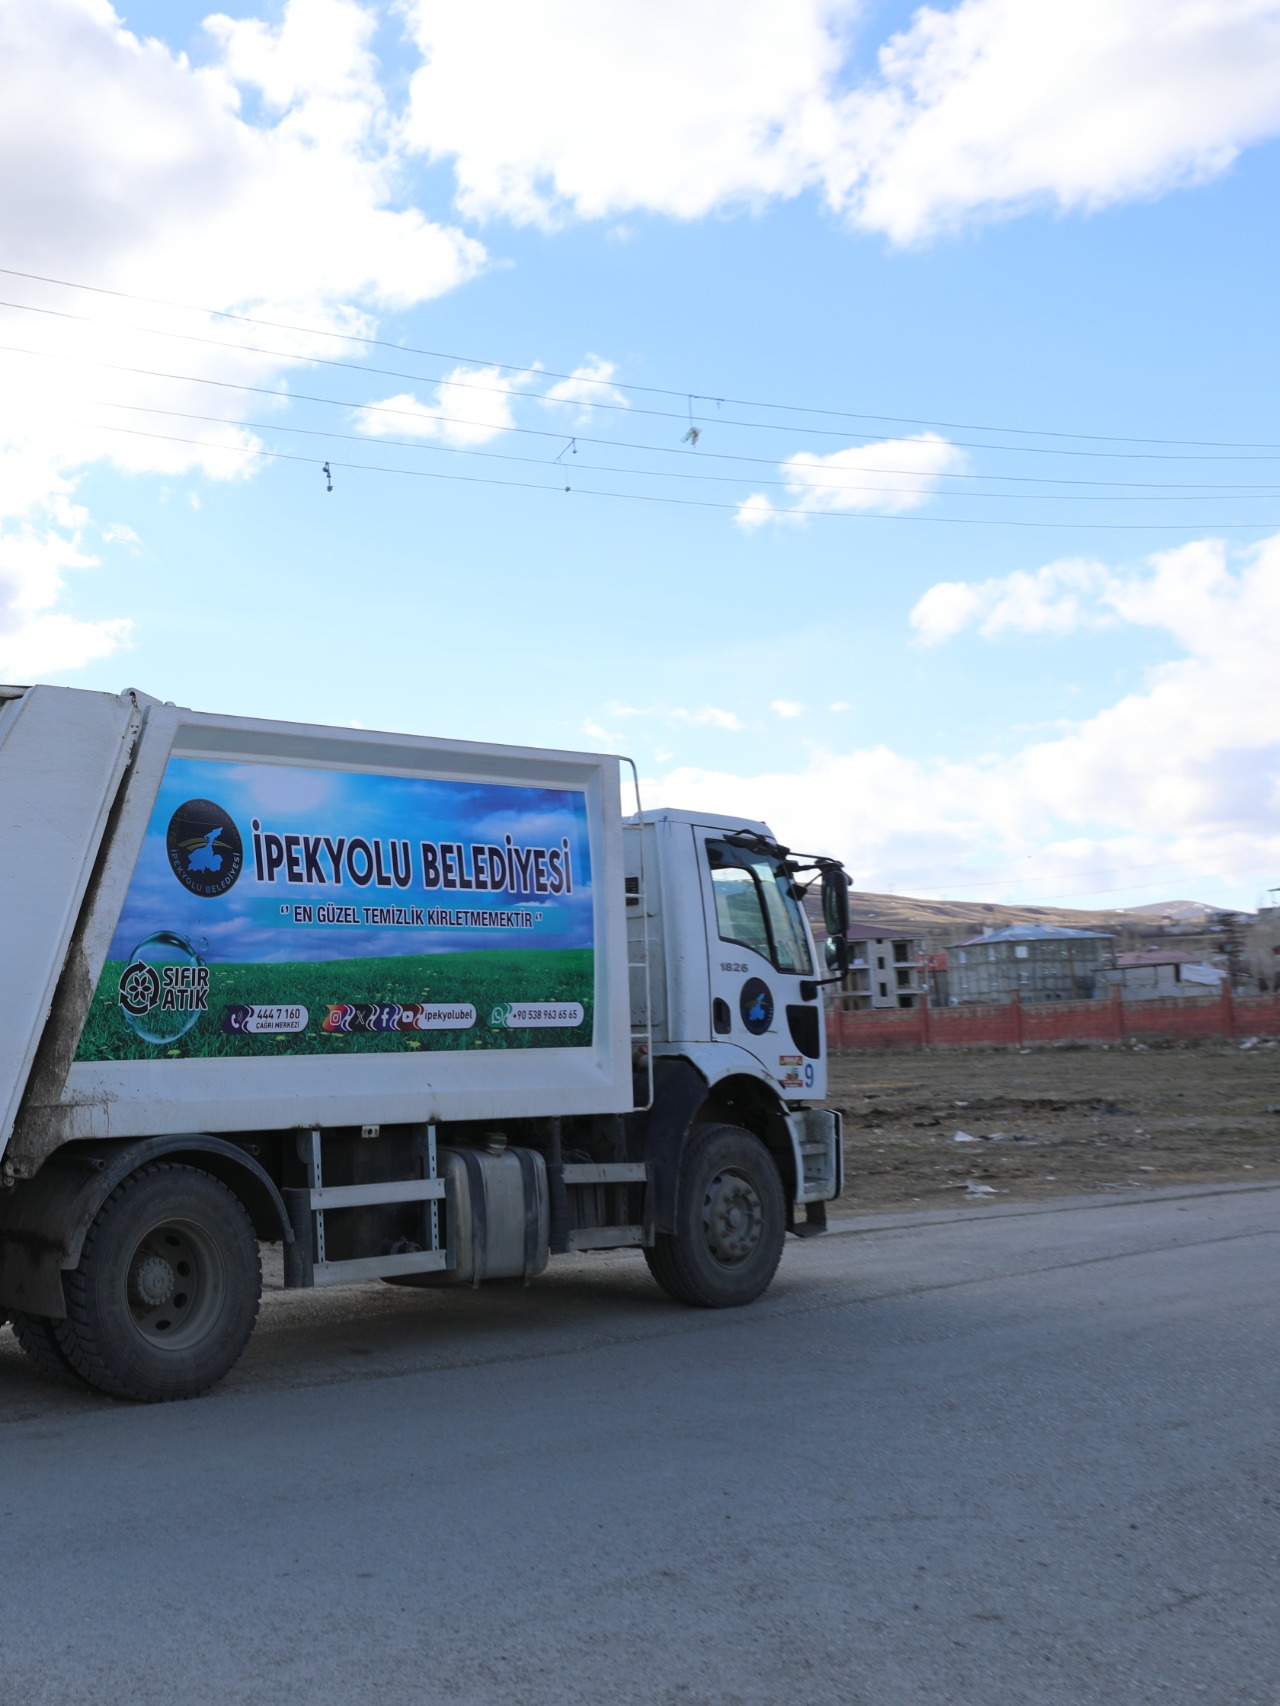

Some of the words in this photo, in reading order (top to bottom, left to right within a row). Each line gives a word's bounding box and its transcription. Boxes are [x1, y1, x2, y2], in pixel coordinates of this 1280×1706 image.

[252, 818, 412, 889] İPEKYOLU
[421, 834, 572, 894] BELEDİYESİ
[294, 905, 313, 923] EN
[317, 903, 360, 924] GÜZEL
[363, 904, 425, 926] TEMİZLİK
[427, 906, 533, 928] KİRLETMEMEKTİR
[720, 962, 749, 973] 1826
[162, 966, 209, 988] SIFIR
[161, 988, 209, 1010] ATIK
[257, 1008, 274, 1020] 444
[276, 1008, 283, 1020] 7
[285, 1008, 300, 1019] 160
[424, 1009, 473, 1022] ipekyolubel
[512, 1010, 527, 1020] +90
[528, 1009, 542, 1020] 538
[543, 1009, 557, 1020] 963
[558, 1009, 567, 1019] 65
[569, 1009, 578, 1019] 65
[274, 1020, 300, 1029] MERKEZİ
[804, 1063, 814, 1088] 9
